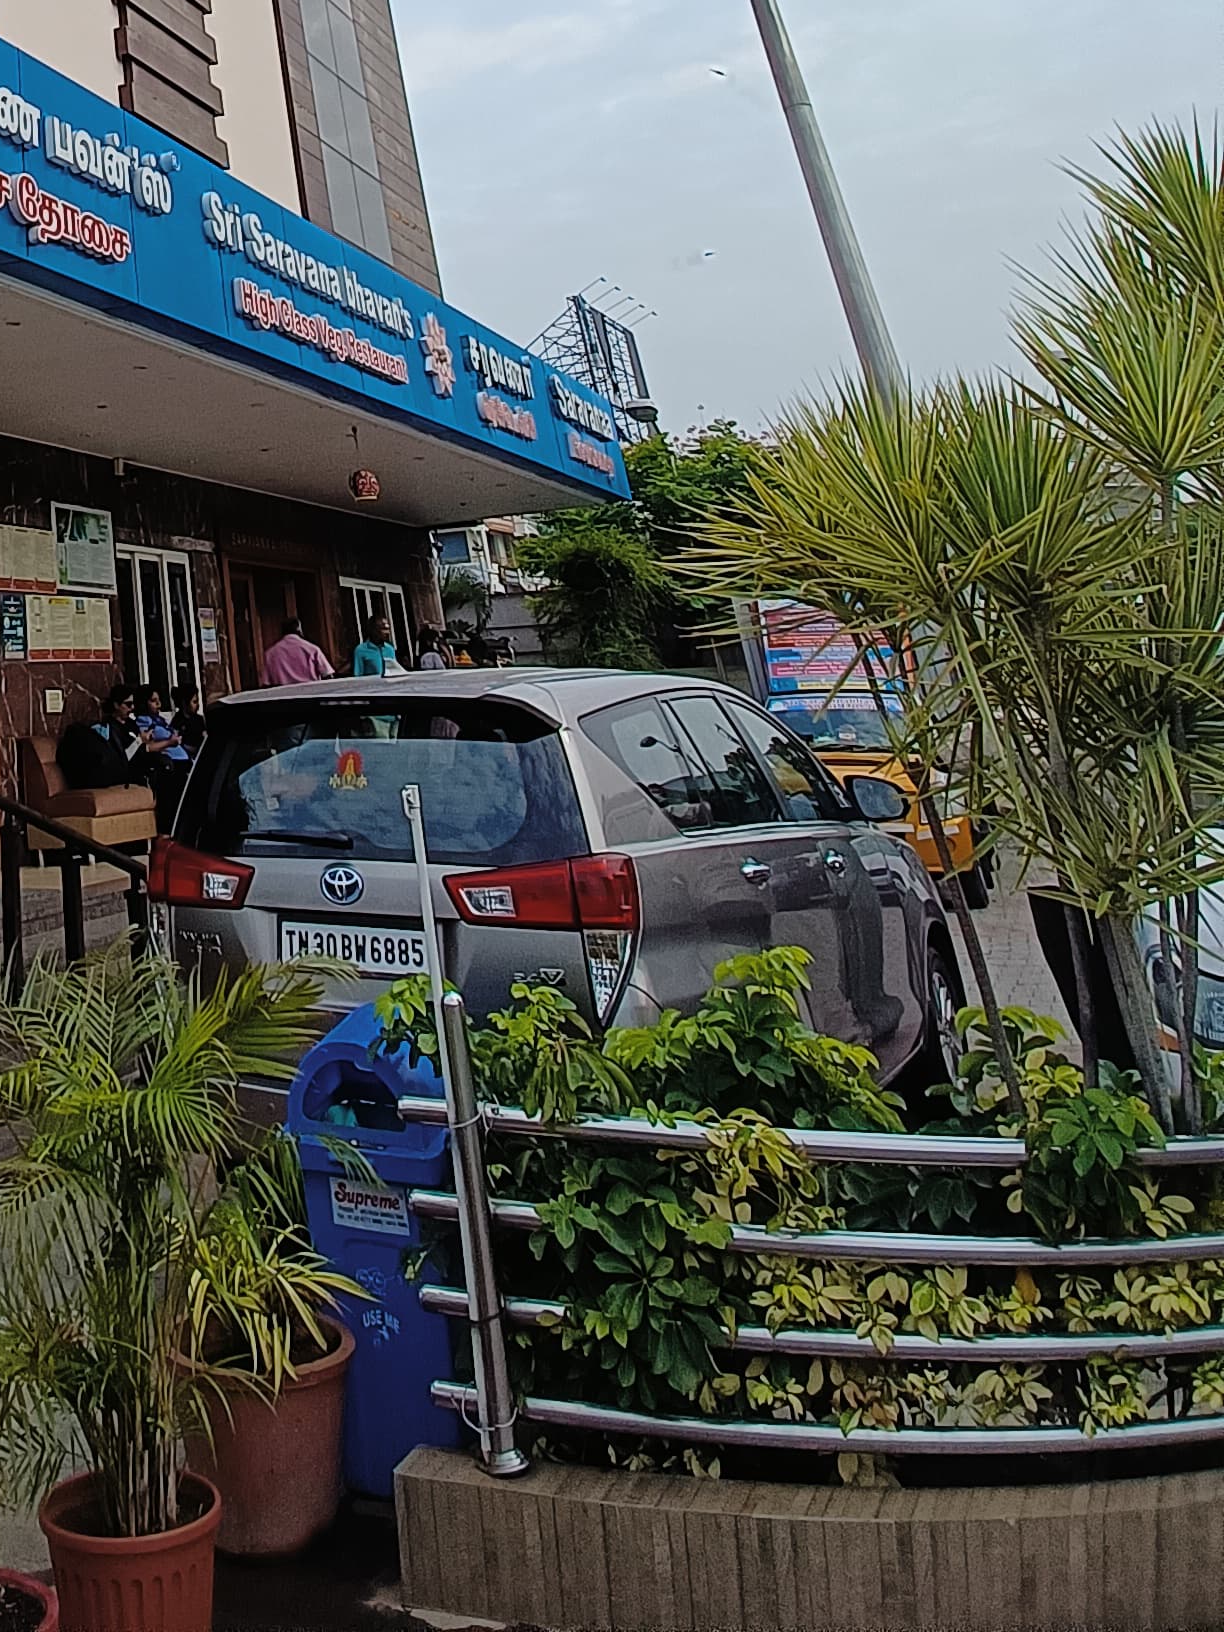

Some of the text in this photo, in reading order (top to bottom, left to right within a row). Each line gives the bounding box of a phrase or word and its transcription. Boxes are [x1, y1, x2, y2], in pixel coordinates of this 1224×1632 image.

[9, 173, 133, 263] தோசை
[202, 191, 245, 252] Sri
[243, 213, 342, 303] Saravana
[233, 277, 279, 330] High
[276, 297, 319, 345] Class
[341, 328, 410, 385] Restaurant
[334, 1181, 401, 1210] Supreme
[362, 1309, 383, 1328] USE
